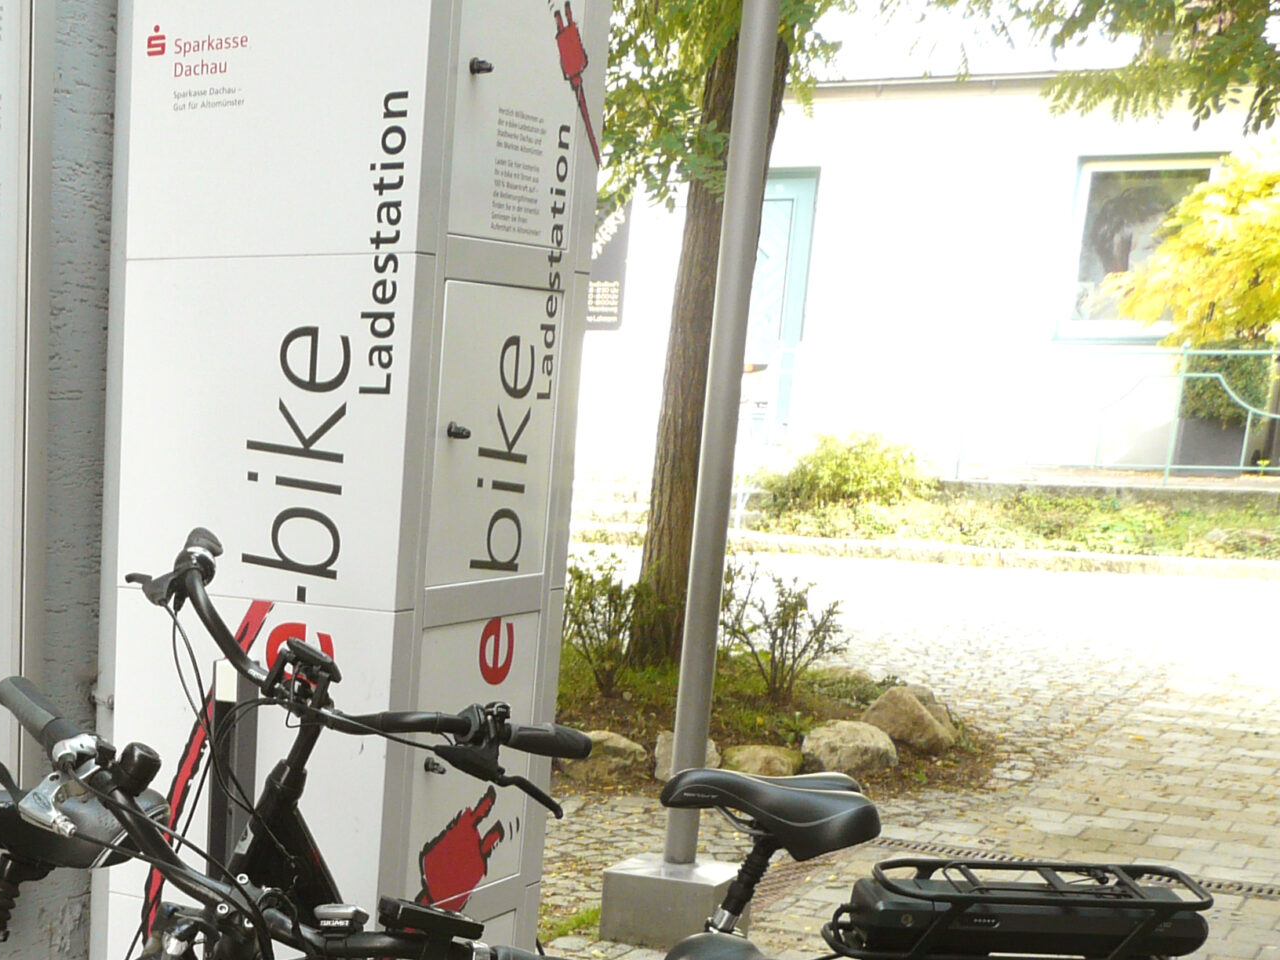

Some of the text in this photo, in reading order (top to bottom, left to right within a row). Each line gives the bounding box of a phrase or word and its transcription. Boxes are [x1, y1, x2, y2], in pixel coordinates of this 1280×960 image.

[174, 34, 248, 57] Sparkasse
[174, 59, 227, 77] Dachau
[173, 86, 236, 100] Sparkasse Dachau
[173, 98, 245, 112] Gut für Altomünster
[359, 90, 409, 395] Ladestation
[536, 124, 571, 400] Ladestation
